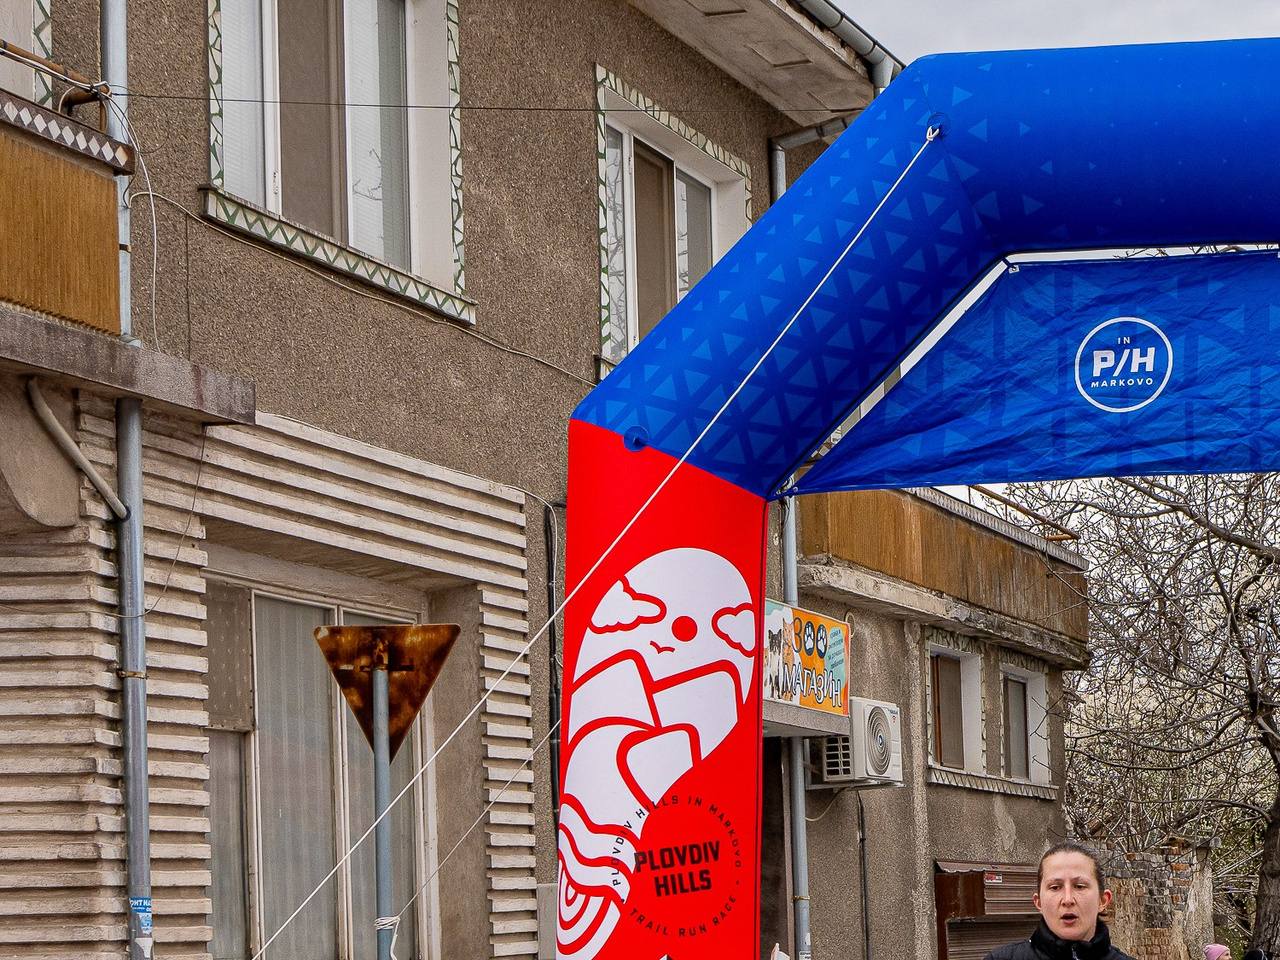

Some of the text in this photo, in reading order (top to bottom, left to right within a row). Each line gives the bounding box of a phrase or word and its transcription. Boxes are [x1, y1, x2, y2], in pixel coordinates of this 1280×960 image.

[1117, 336, 1130, 345] IN
[1092, 347, 1155, 377] P/H
[1090, 377, 1154, 388] MARKOVO
[783, 662, 842, 708] МАГАЗИН
[611, 795, 741, 886] PLOVDIV HILLS IN MARKOVO
[634, 840, 720, 873] PLOVDIV
[654, 869, 712, 897] HILLS
[630, 895, 736, 937] TRAIL RUN RACE
